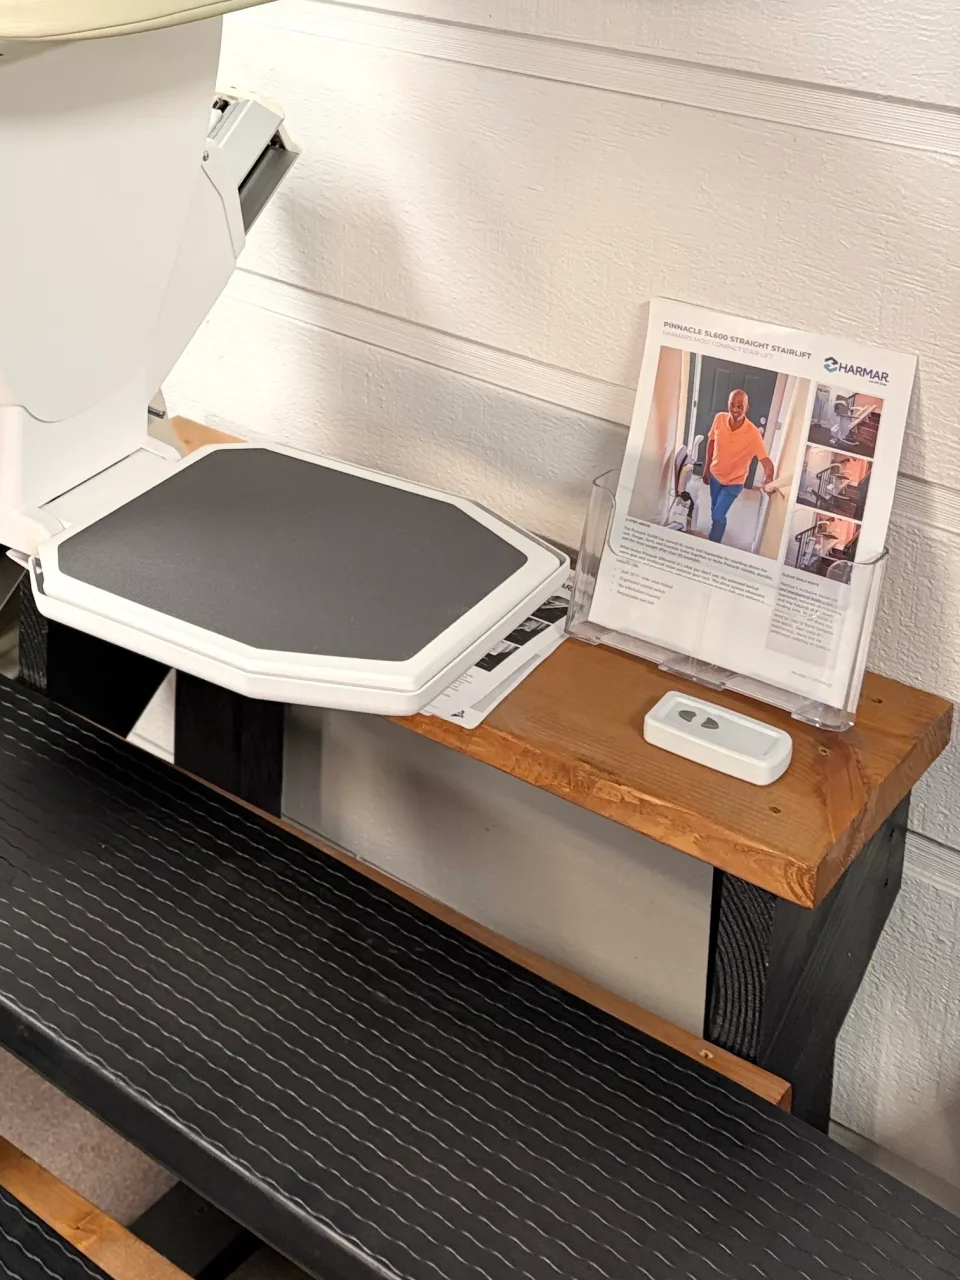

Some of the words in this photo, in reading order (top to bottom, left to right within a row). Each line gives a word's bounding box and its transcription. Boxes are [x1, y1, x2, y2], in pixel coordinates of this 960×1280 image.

[664, 322, 702, 335] PINNACLE
[705, 331, 728, 341] SL600
[730, 336, 769, 350] STRAIGHT
[772, 345, 812, 359] STAIRLIFT
[839, 362, 889, 383] HARMAR
